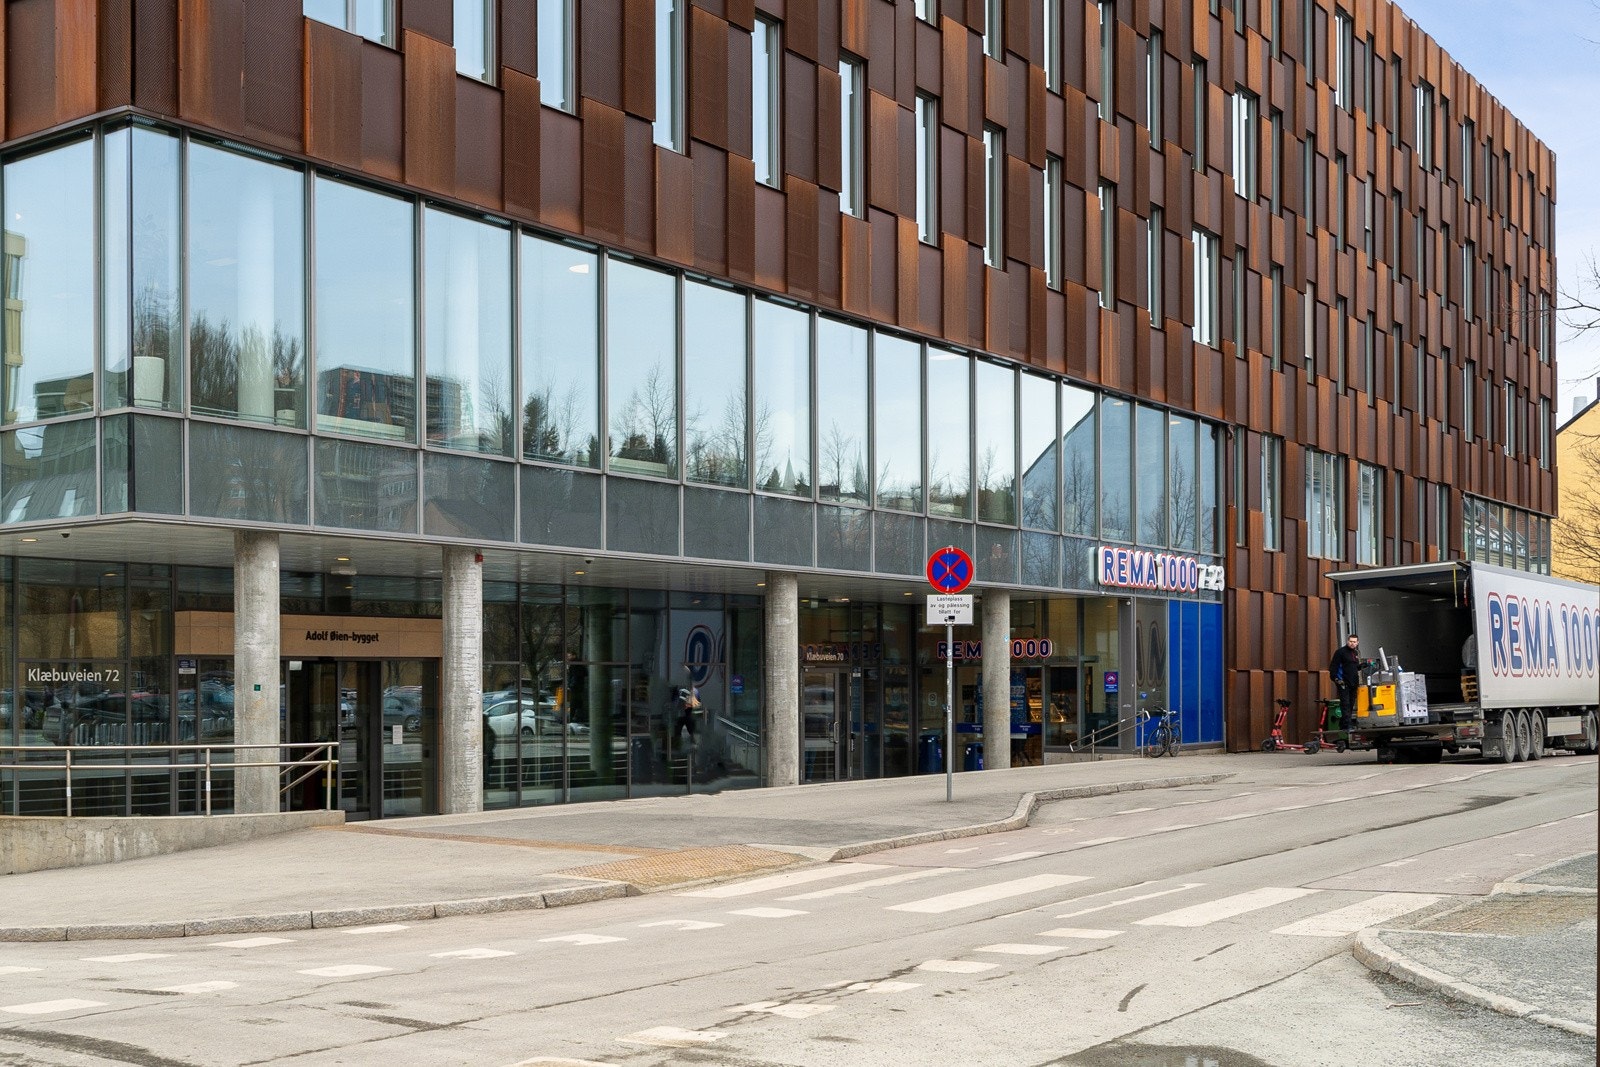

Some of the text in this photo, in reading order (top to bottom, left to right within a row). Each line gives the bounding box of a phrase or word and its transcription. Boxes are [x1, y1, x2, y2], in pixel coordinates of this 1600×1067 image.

[1102, 546, 1157, 589] REMA
[1158, 553, 1197, 593] 1000
[305, 630, 379, 644] Adolf Øien-bygget
[1488, 592, 1560, 678] REMA
[837, 652, 845, 661] 70
[937, 638, 1052, 659] REM 000
[28, 667, 120, 682] Klæbuveien 72
